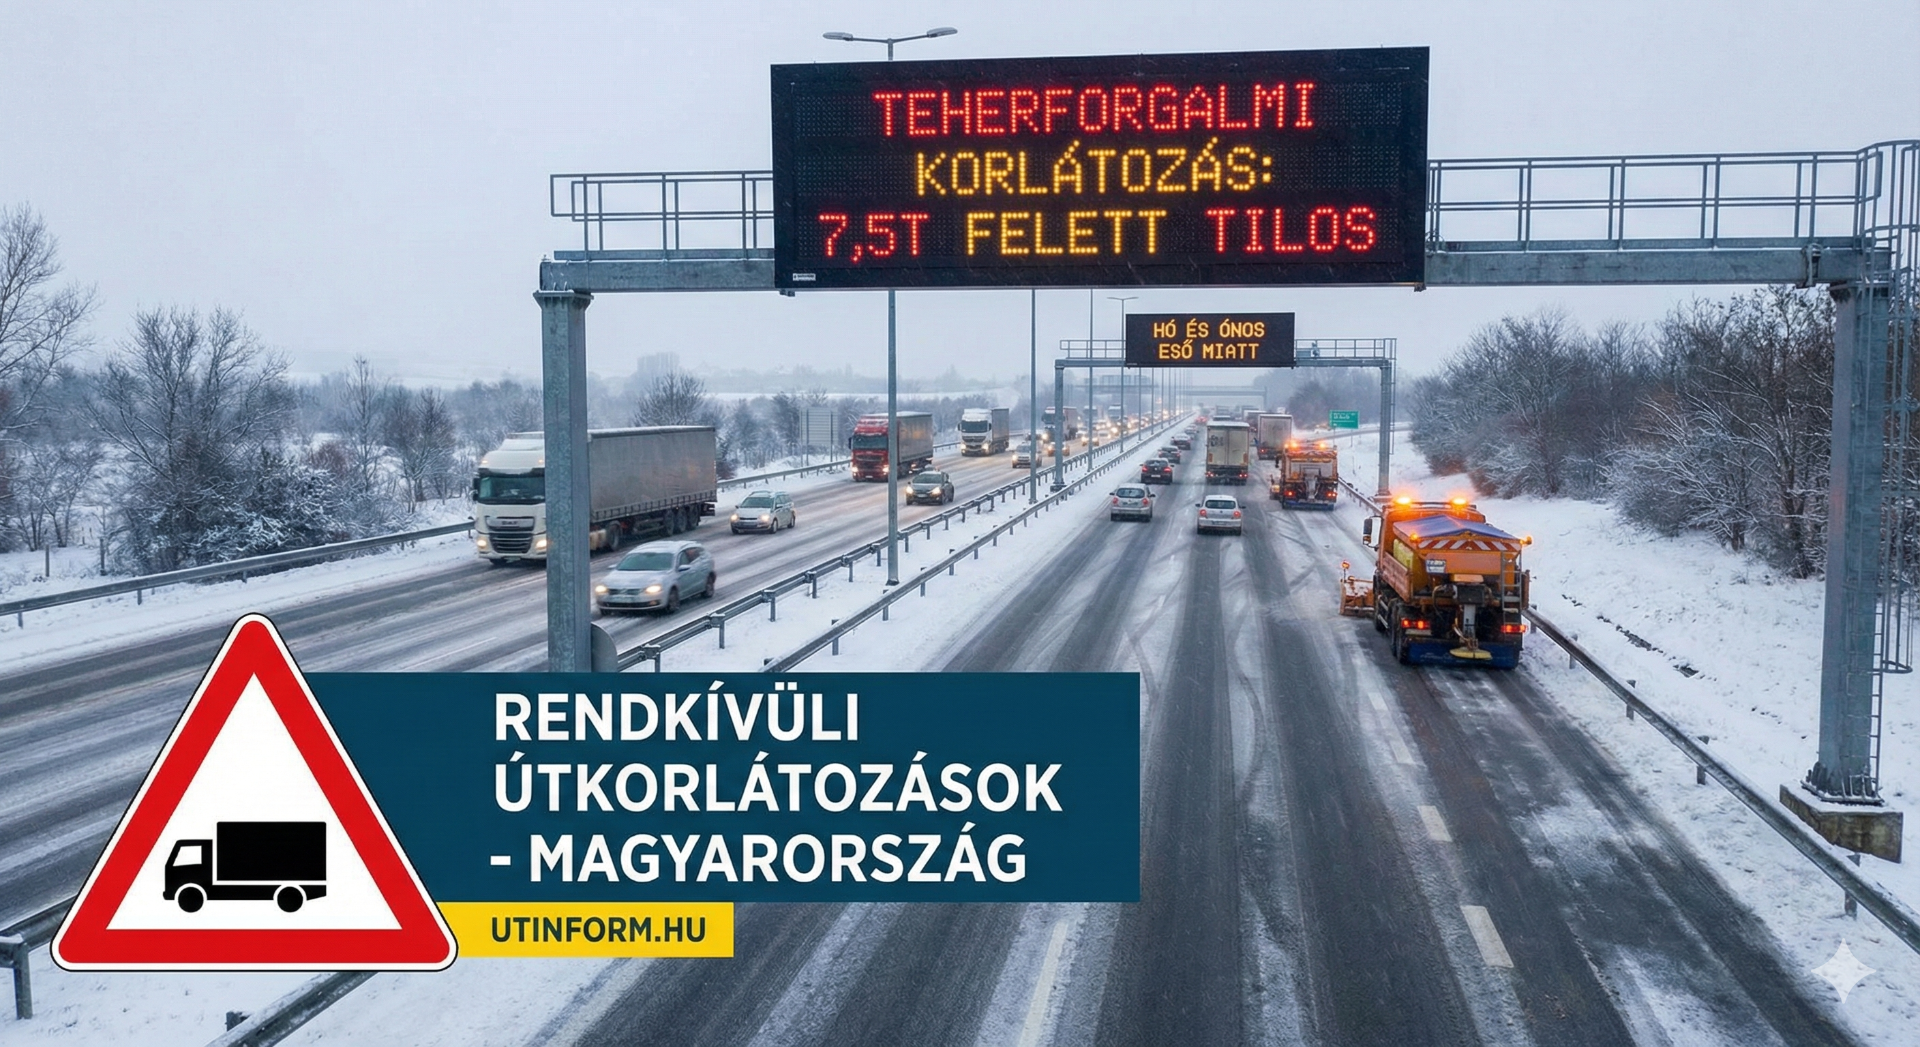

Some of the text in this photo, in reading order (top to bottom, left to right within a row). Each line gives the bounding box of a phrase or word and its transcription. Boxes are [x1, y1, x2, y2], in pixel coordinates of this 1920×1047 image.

[874, 83, 1315, 136] TEHERFORGALMI
[915, 138, 1272, 196] KORLÁTOZÁS:
[819, 207, 1376, 262] 7,5T FELETT TILOS
[1154, 318, 1265, 338] HÓ ÉS ÓNOS
[1158, 339, 1260, 359] ESŐ MIATT
